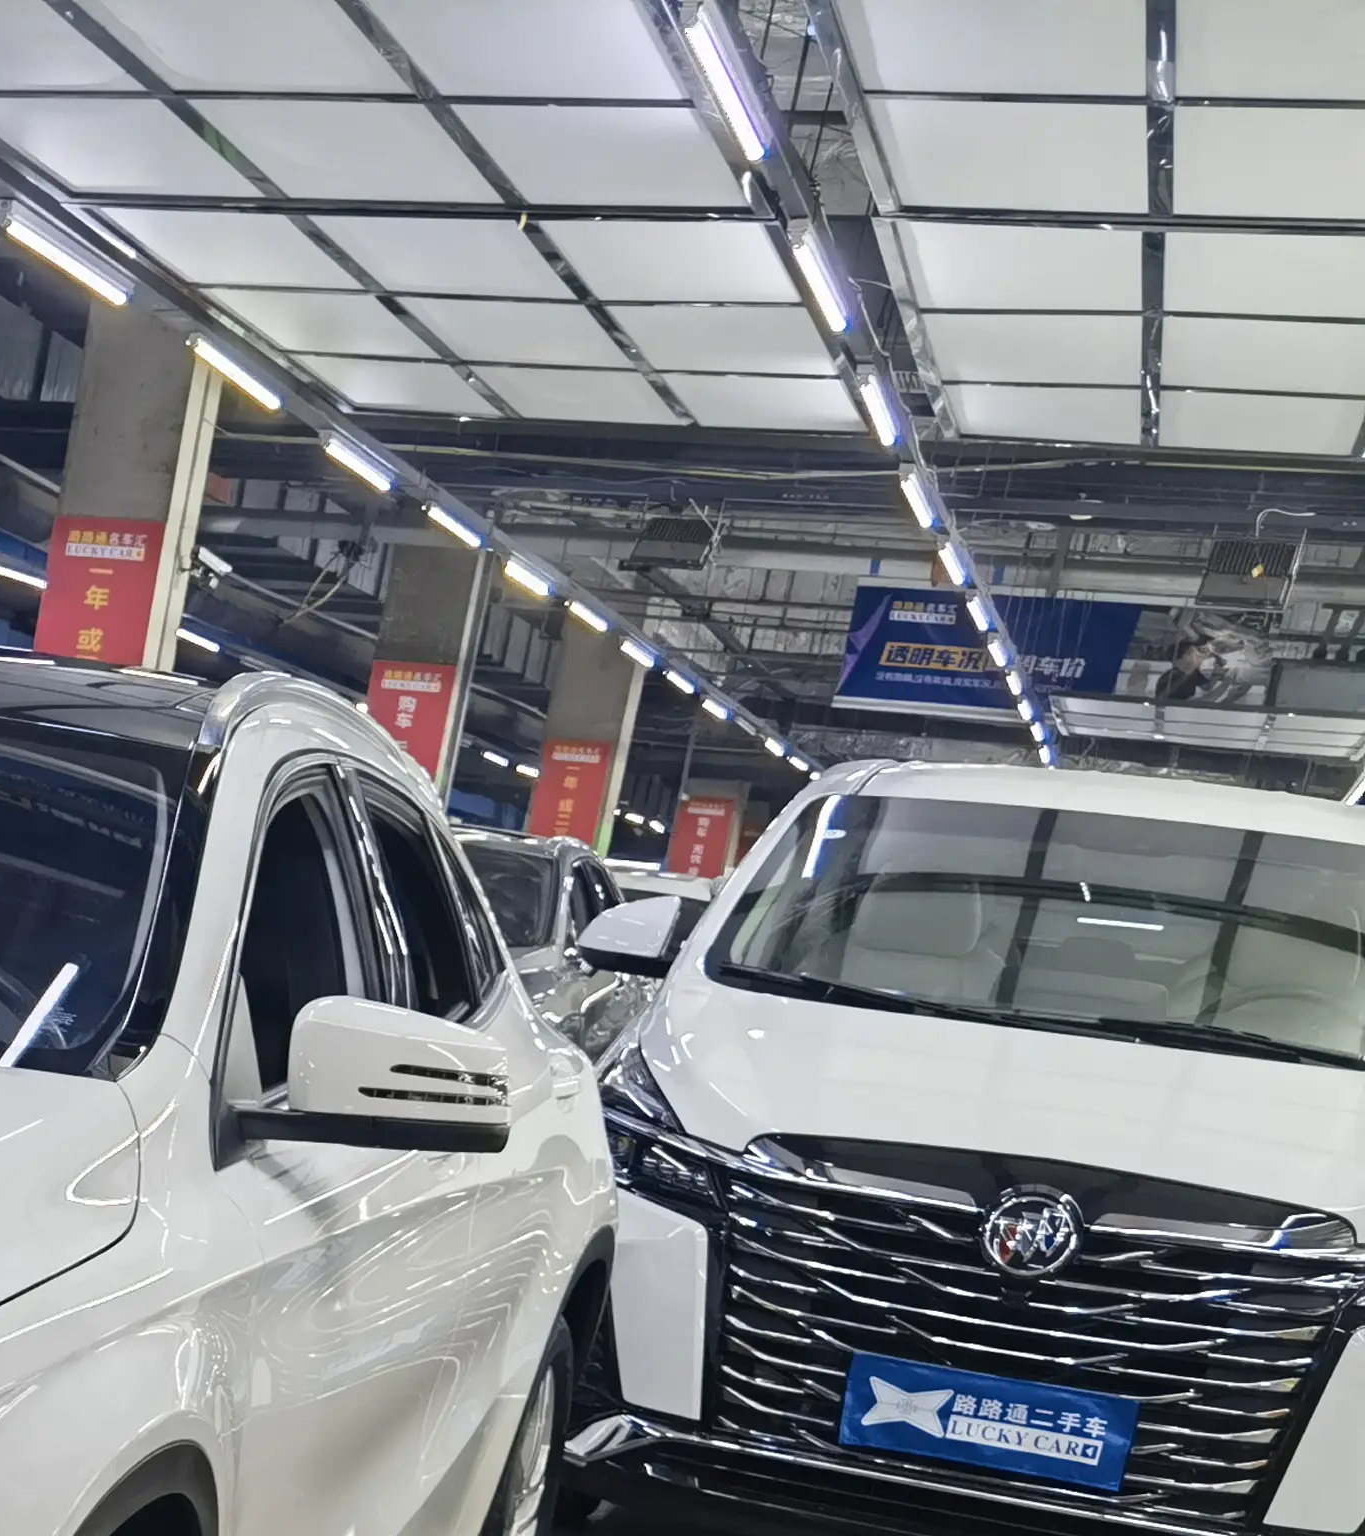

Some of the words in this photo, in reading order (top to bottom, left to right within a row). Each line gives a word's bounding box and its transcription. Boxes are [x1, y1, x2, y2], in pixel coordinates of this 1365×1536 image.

[953, 1394, 1108, 1438] 路路通二手车
[950, 1419, 1028, 1448] LUCKY
[1033, 1434, 1082, 1458] CAR
